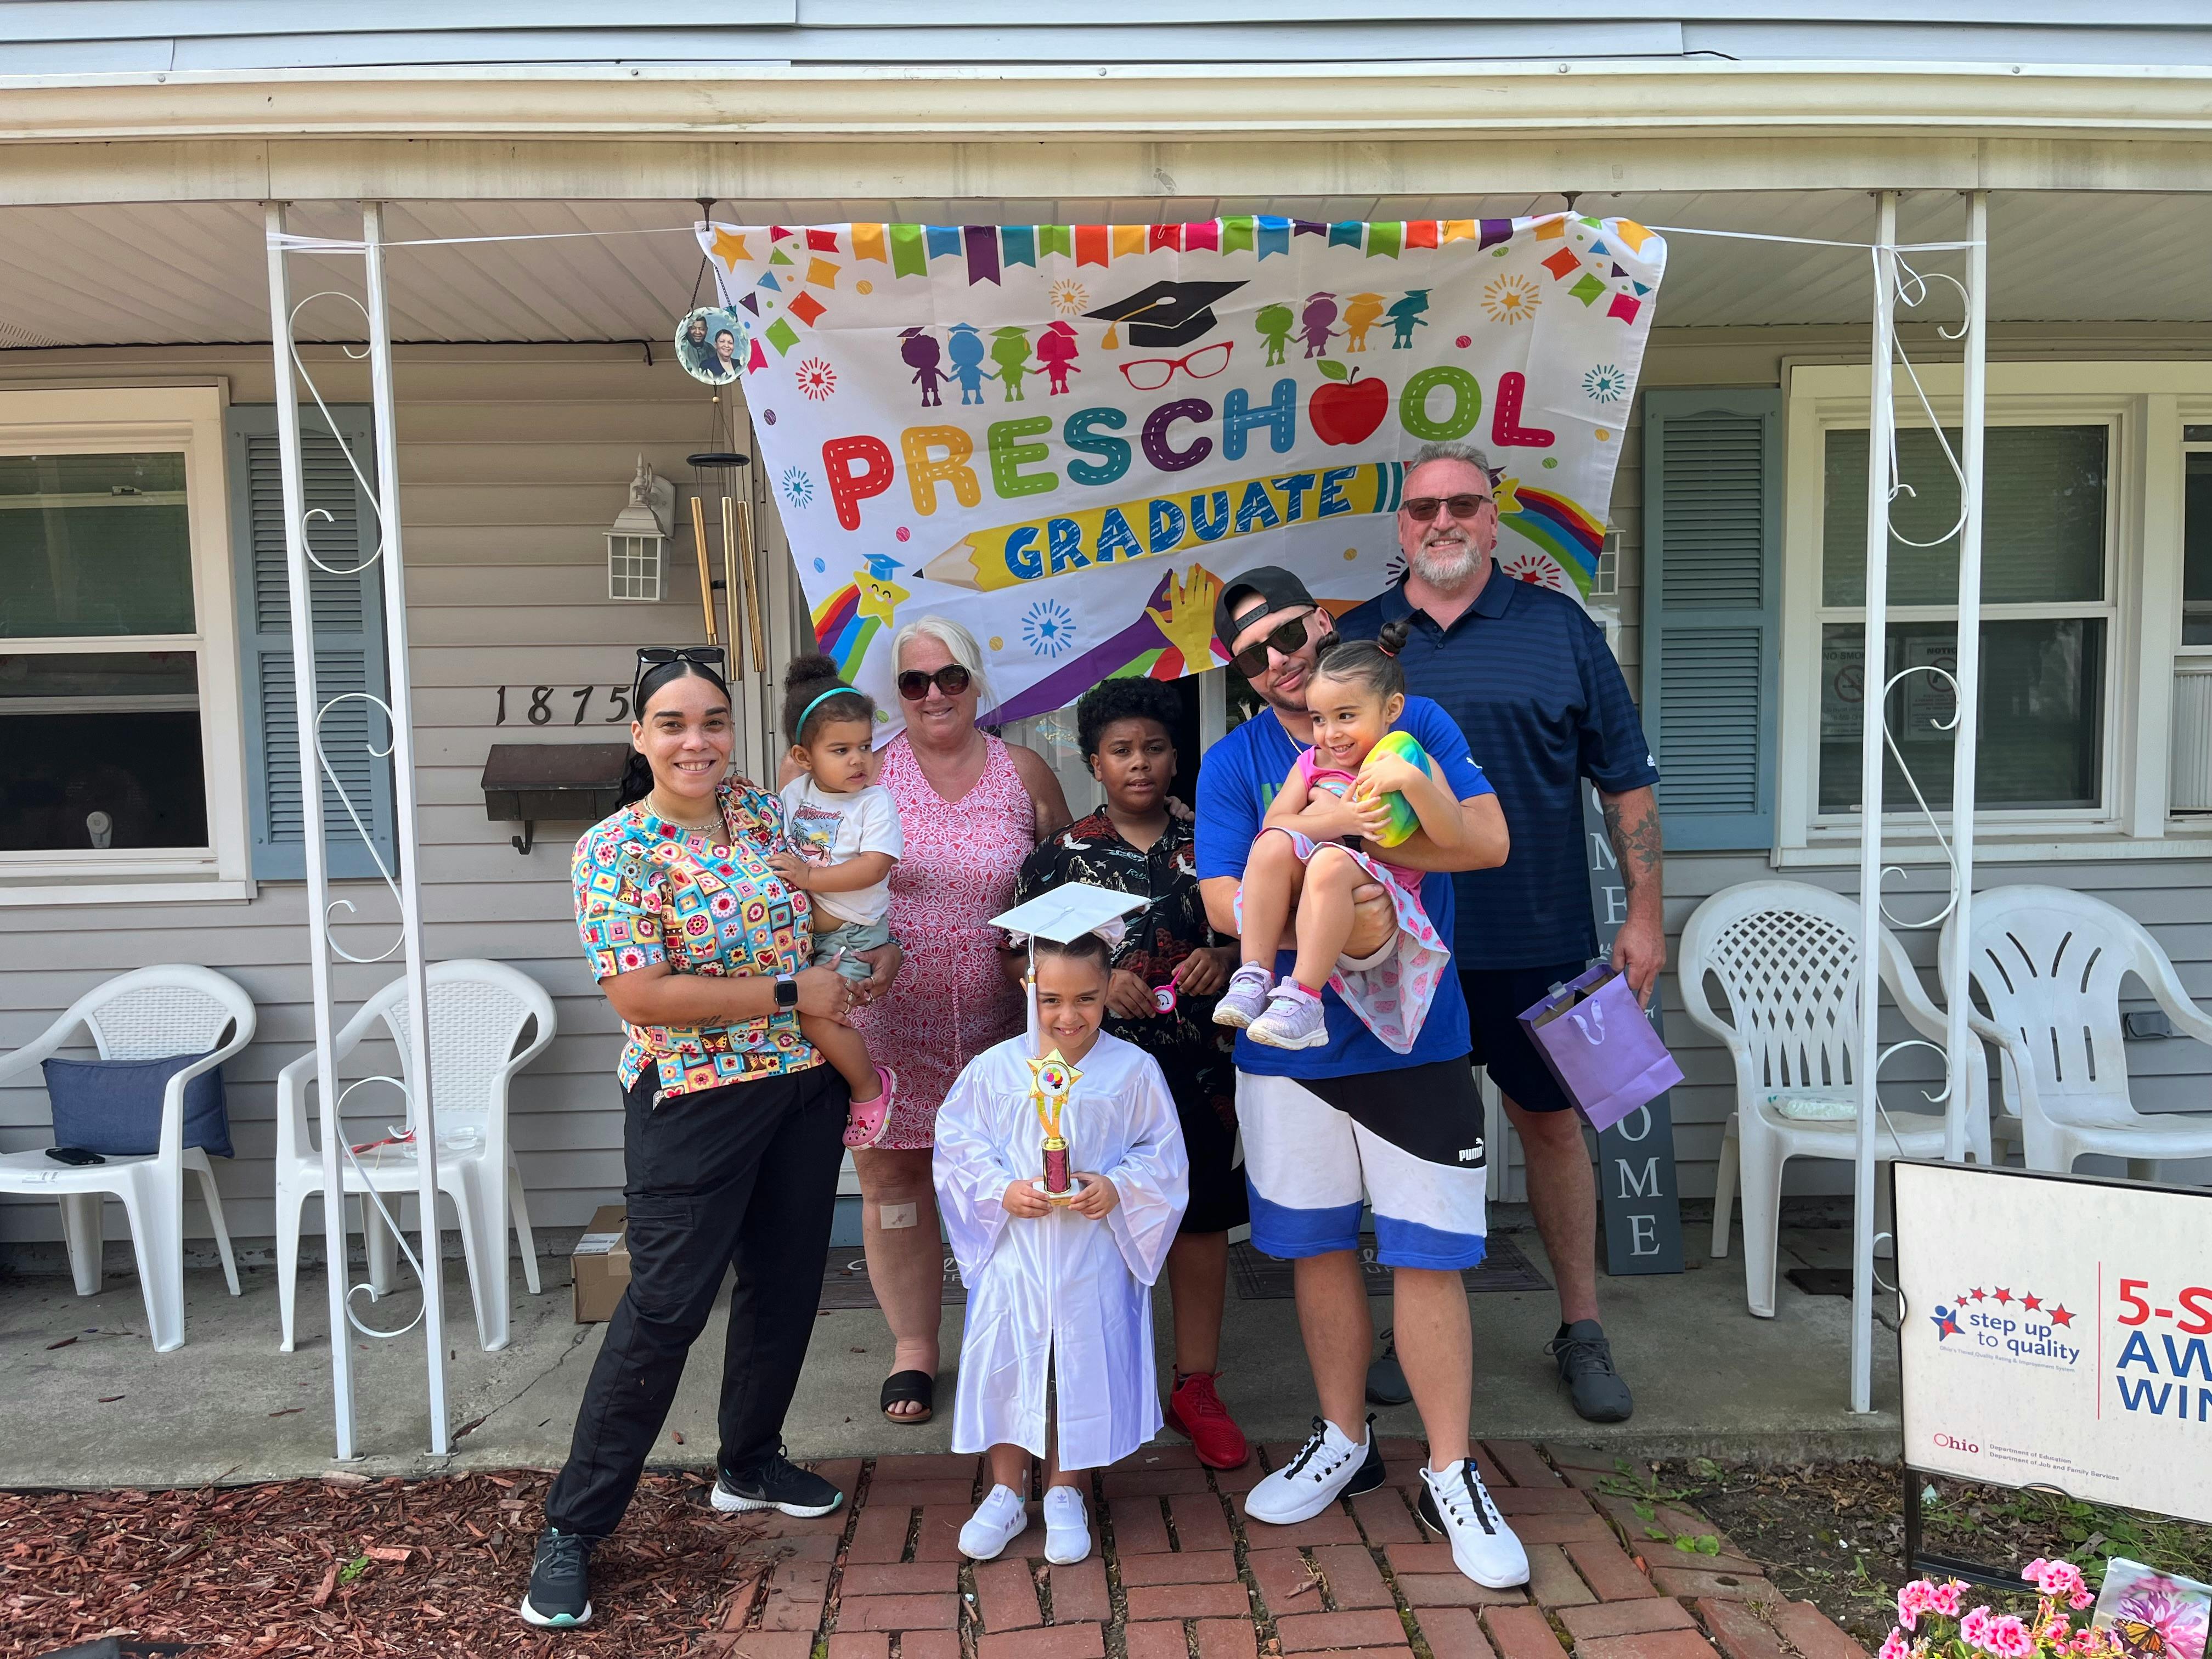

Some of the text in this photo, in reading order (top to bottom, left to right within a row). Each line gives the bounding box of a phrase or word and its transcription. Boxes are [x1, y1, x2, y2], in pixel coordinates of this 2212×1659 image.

[1003, 466, 1355, 580] GRADUATE
[1823, 651, 1865, 661] NO SMO
[1926, 647, 1957, 655] NOTIC
[496, 686, 630, 726] 1875
[1459, 1146, 1483, 1161] PUMA
[1615, 1105, 1663, 1256] OME
[1970, 1313, 2052, 1341] step up
[1975, 1351, 1994, 1361] Quality
[1995, 1355, 2012, 1364] Rating
[2019, 1360, 2055, 1370] Improvement
[1978, 1331, 2080, 1365] to quality
[2116, 1330, 2212, 1382] AW
[1934, 1433, 1979, 1453] Ohio
[1990, 1443, 2029, 1456] Department
[2039, 1453, 2072, 1464] Education
[1990, 1452, 2029, 1464] Department
[2067, 1466, 2089, 1476] Family
[2091, 1471, 2120, 1481] Services
